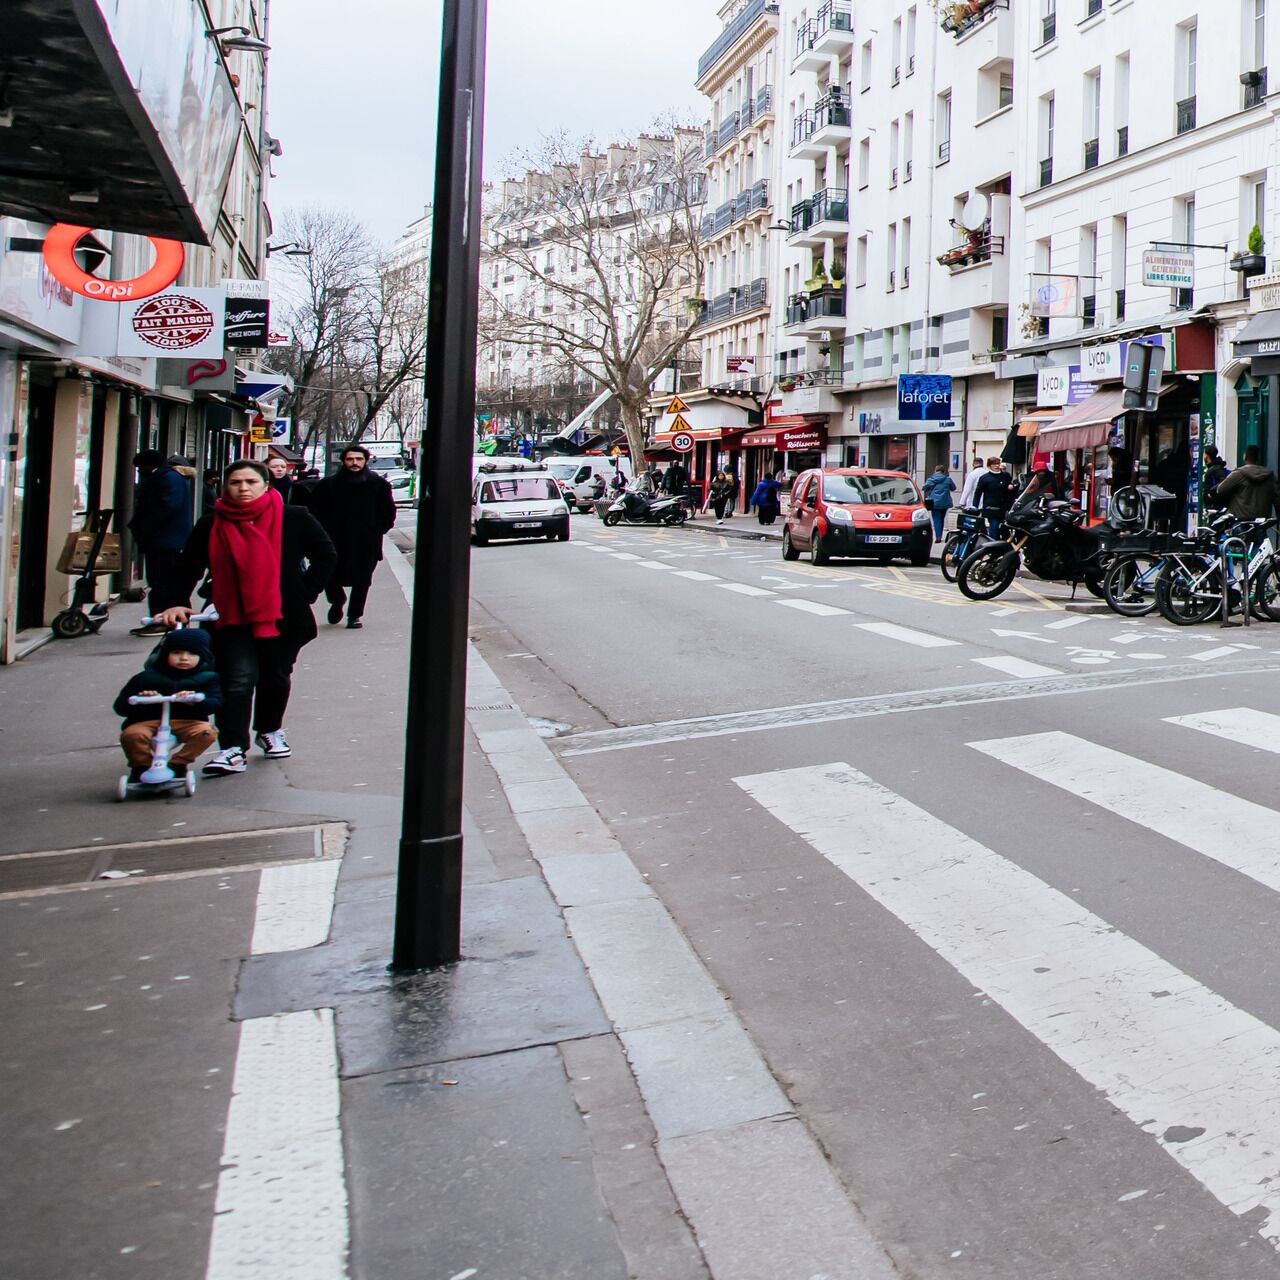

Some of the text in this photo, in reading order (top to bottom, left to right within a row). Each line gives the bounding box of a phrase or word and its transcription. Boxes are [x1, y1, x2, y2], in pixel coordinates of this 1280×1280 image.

[1166, 274, 1191, 282] SERVICE
[84, 280, 133, 299] Orpi
[153, 299, 192, 310] 100%
[133, 315, 212, 328] FAIT MAISON
[153, 335, 191, 346] 100%
[900, 389, 949, 404] laforêt
[783, 432, 819, 440] Boucherie
[676, 437, 690, 447] 30
